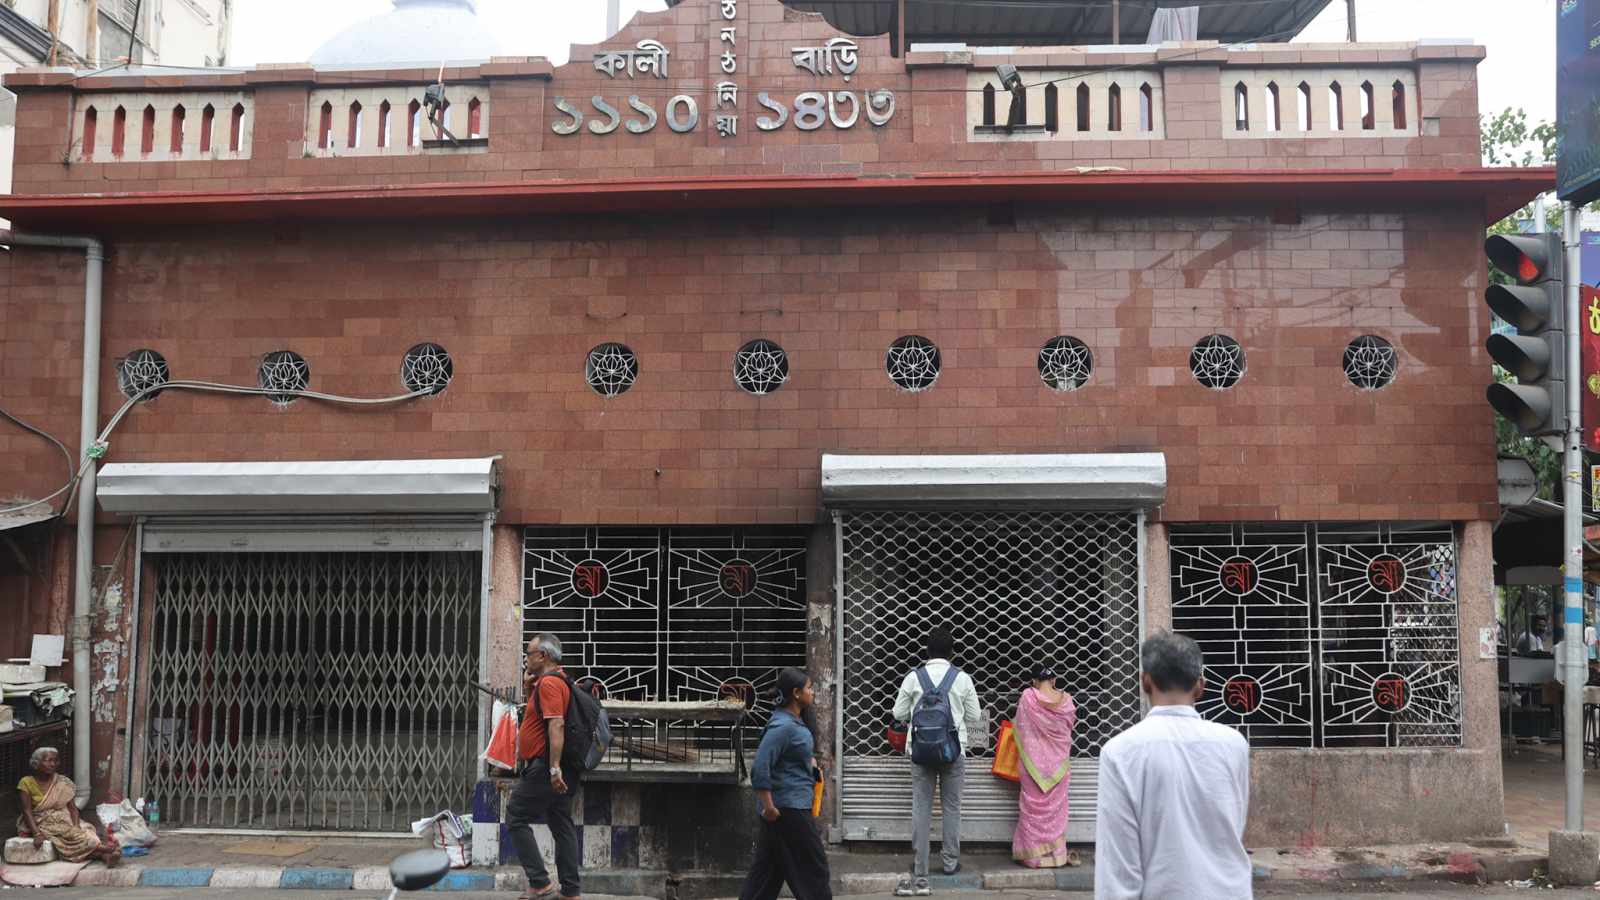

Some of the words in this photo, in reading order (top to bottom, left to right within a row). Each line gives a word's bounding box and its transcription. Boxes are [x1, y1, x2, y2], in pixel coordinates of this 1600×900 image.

[592, 39, 669, 79] কালী
[791, 37, 858, 82] বাড়ি
[551, 94, 699, 135] ১১১০
